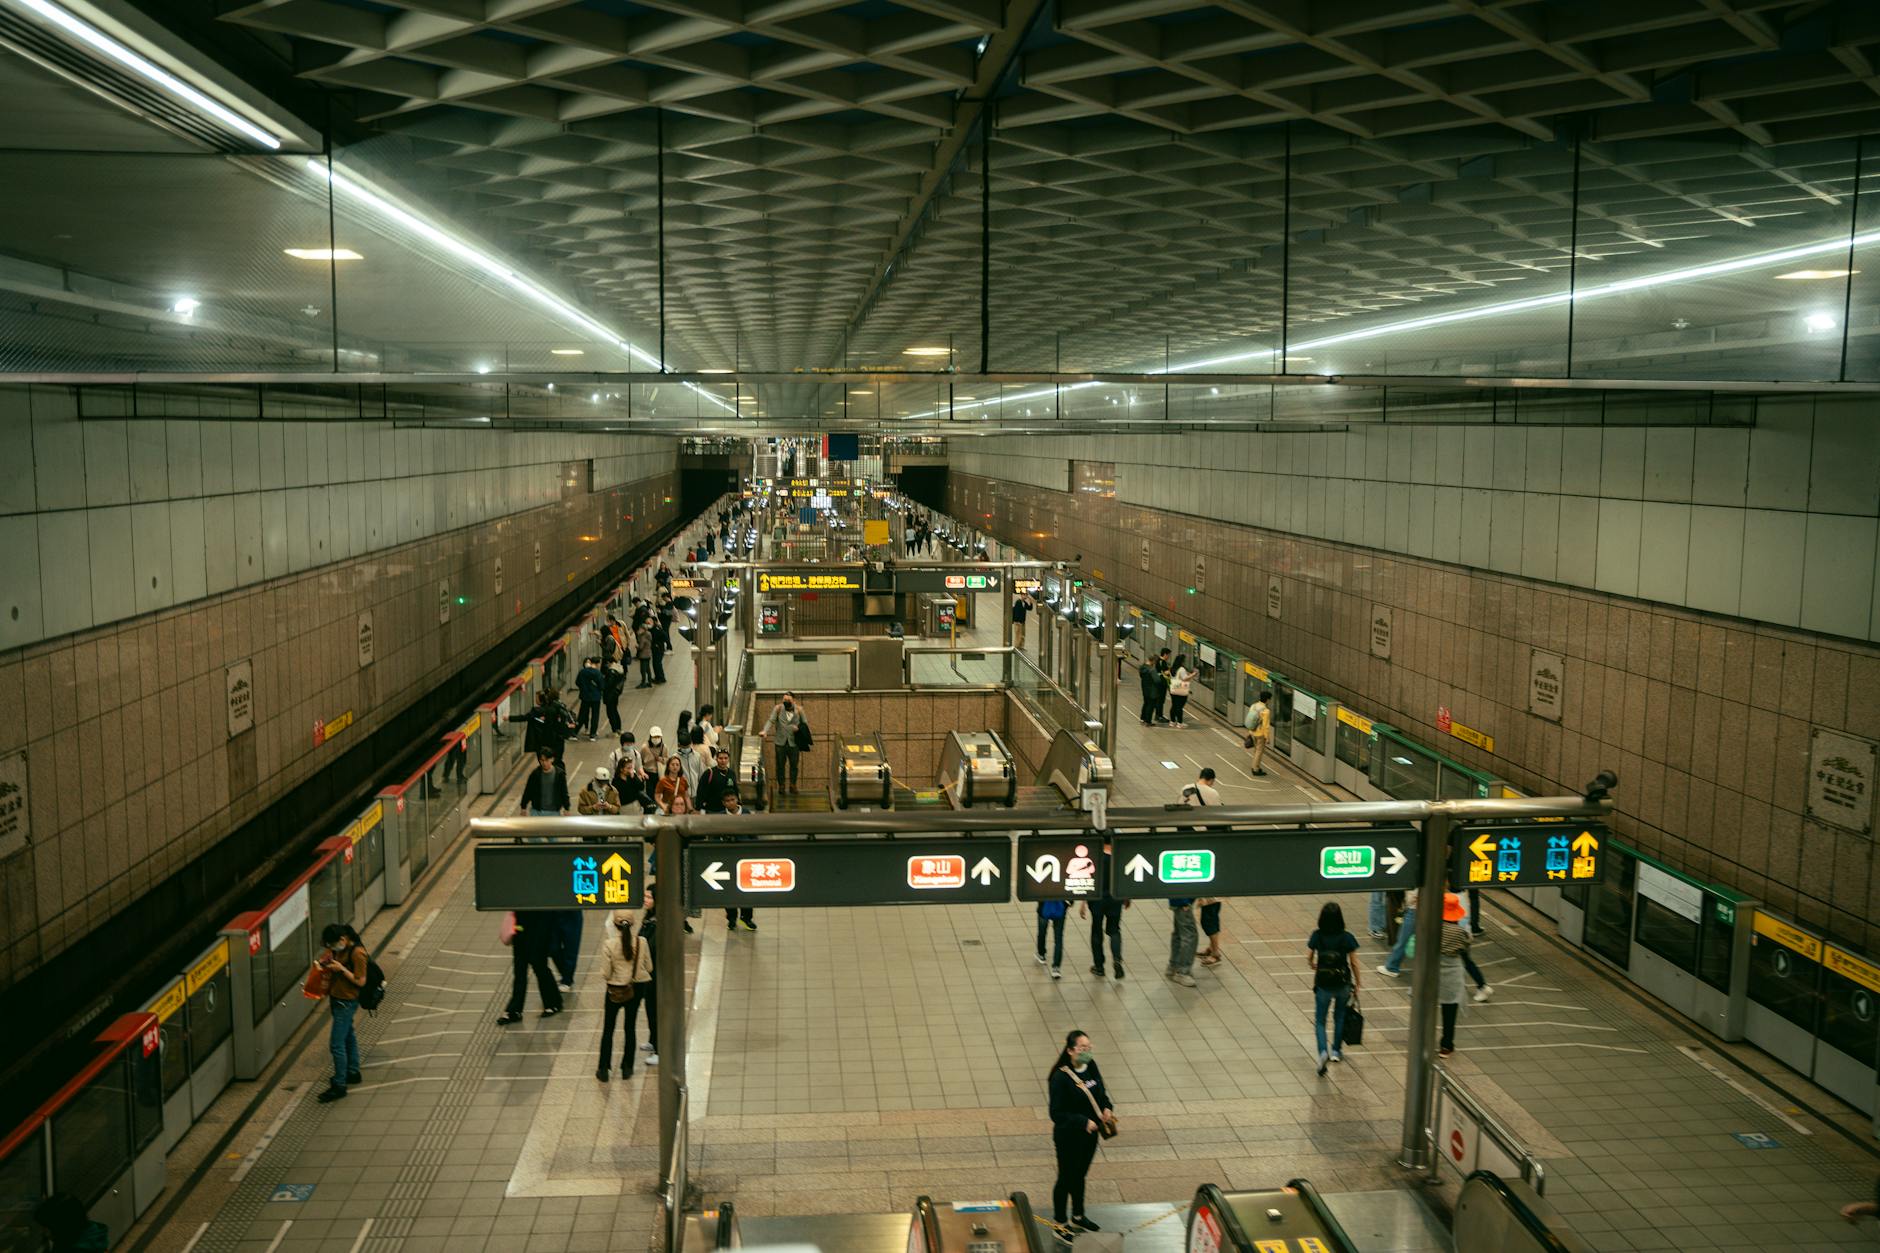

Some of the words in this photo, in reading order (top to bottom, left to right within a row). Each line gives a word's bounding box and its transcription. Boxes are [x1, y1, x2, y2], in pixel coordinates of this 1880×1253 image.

[1333, 850, 1362, 865] 松山
[750, 863, 781, 878] 淡水
[1326, 865, 1369, 875] Songshan
[1498, 871, 1519, 881] 5-7
